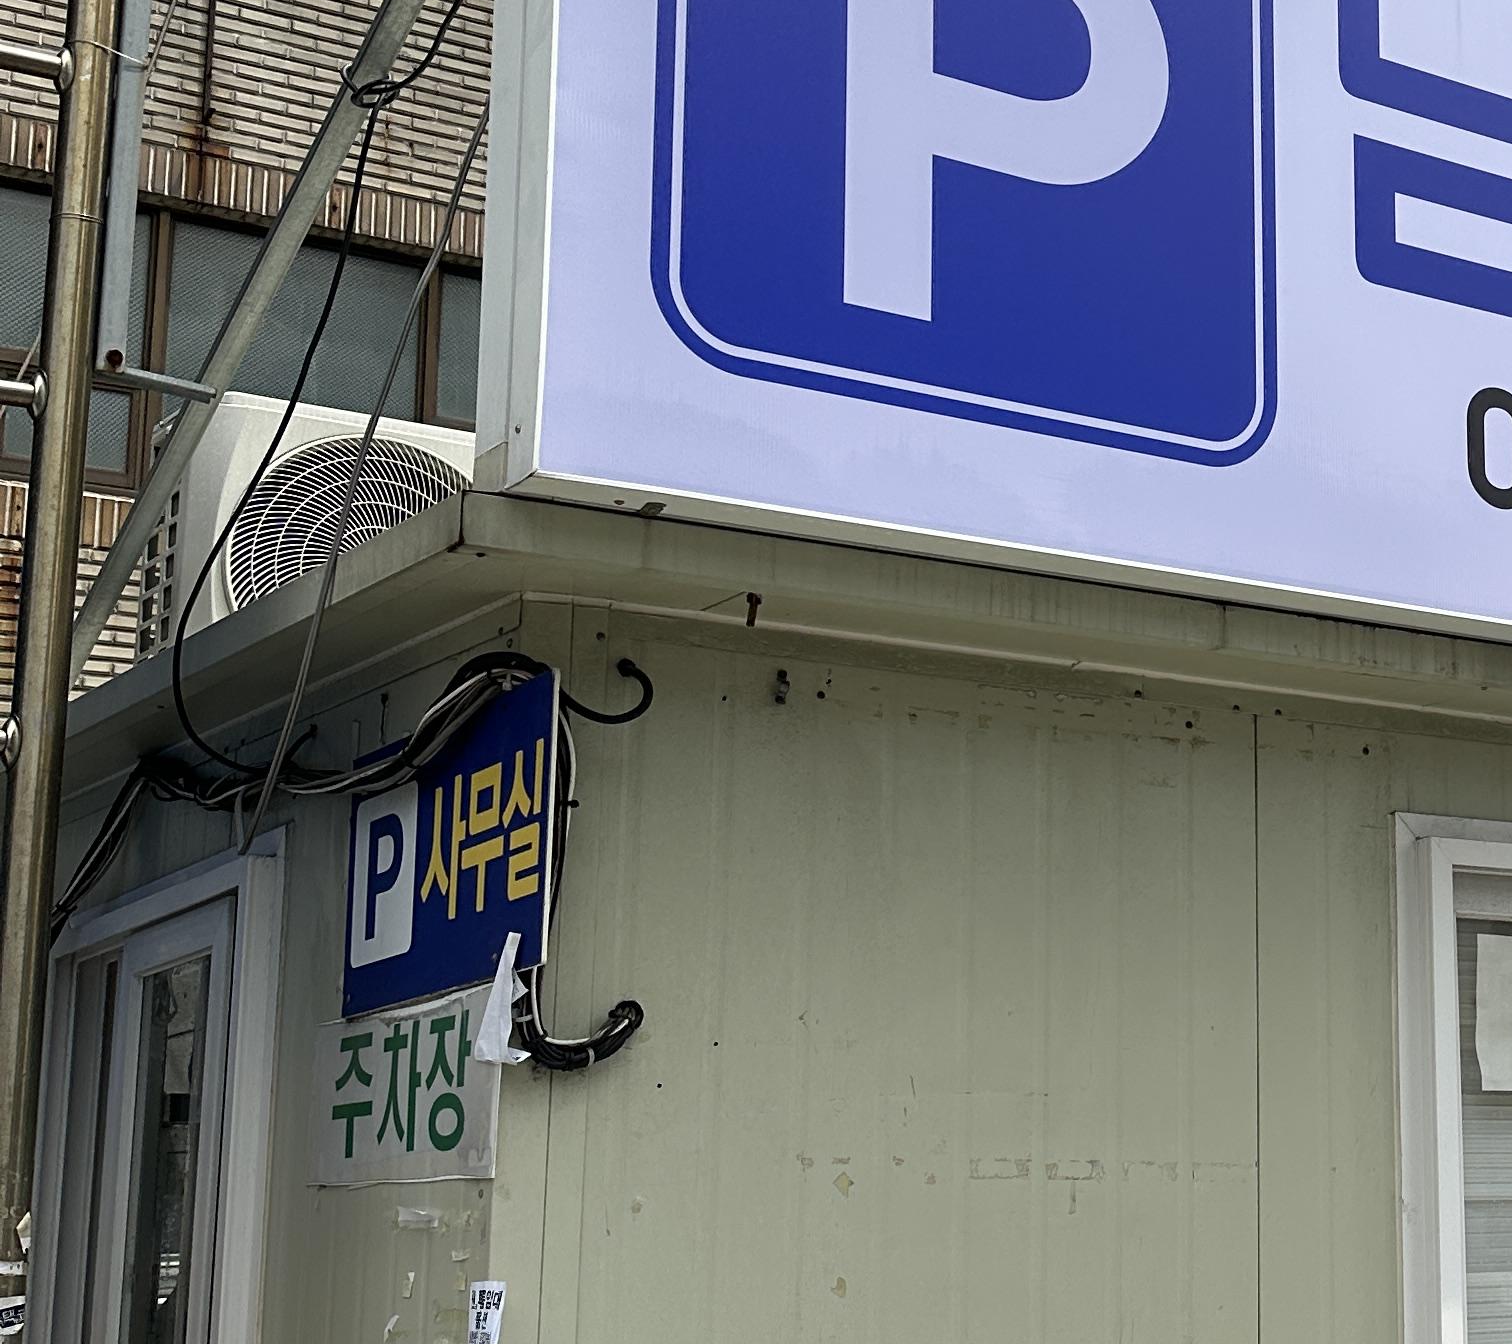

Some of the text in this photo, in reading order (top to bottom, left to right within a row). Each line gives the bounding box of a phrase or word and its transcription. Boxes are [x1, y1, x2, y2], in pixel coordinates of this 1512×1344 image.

[366, 813, 403, 941] P
[420, 737, 546, 920] 사무실
[331, 1009, 473, 1159] 주차장
